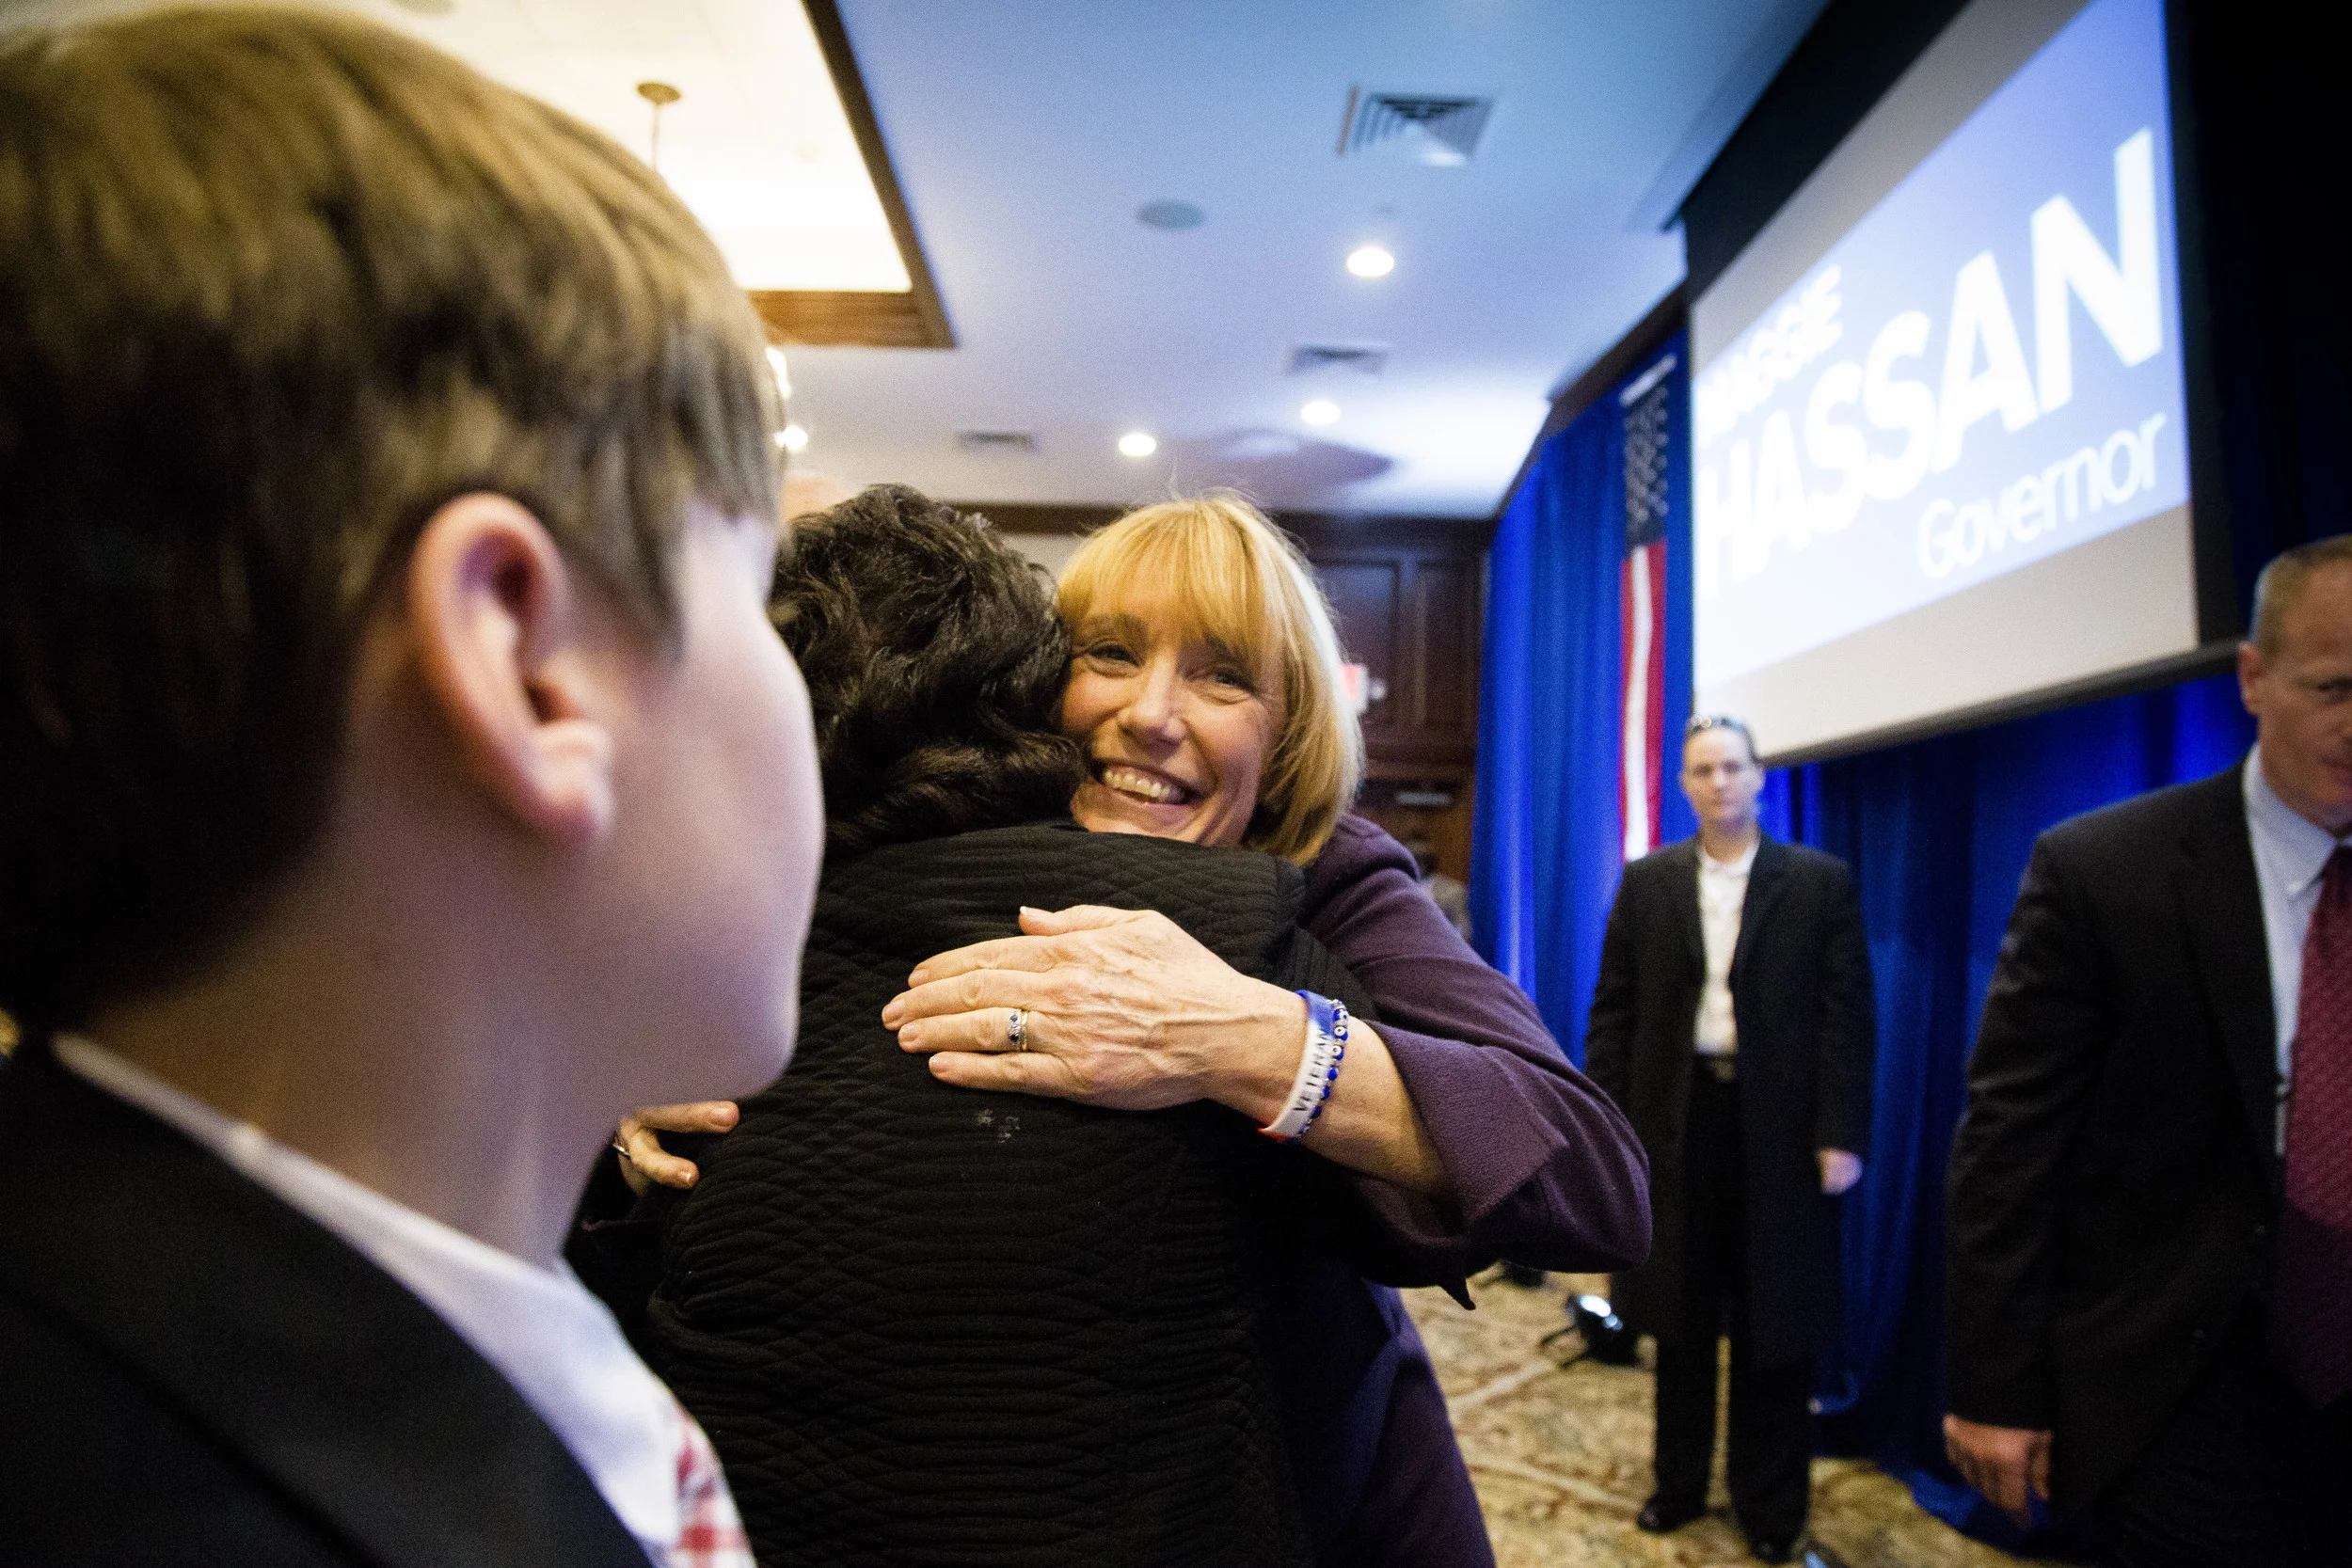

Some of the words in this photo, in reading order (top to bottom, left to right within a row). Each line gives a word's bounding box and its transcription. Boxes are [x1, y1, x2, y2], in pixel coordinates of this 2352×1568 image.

[1698, 127, 2162, 598] HASSAN
[1916, 413, 2167, 579] Governor
[1292, 1027, 1331, 1112] VETERAN
